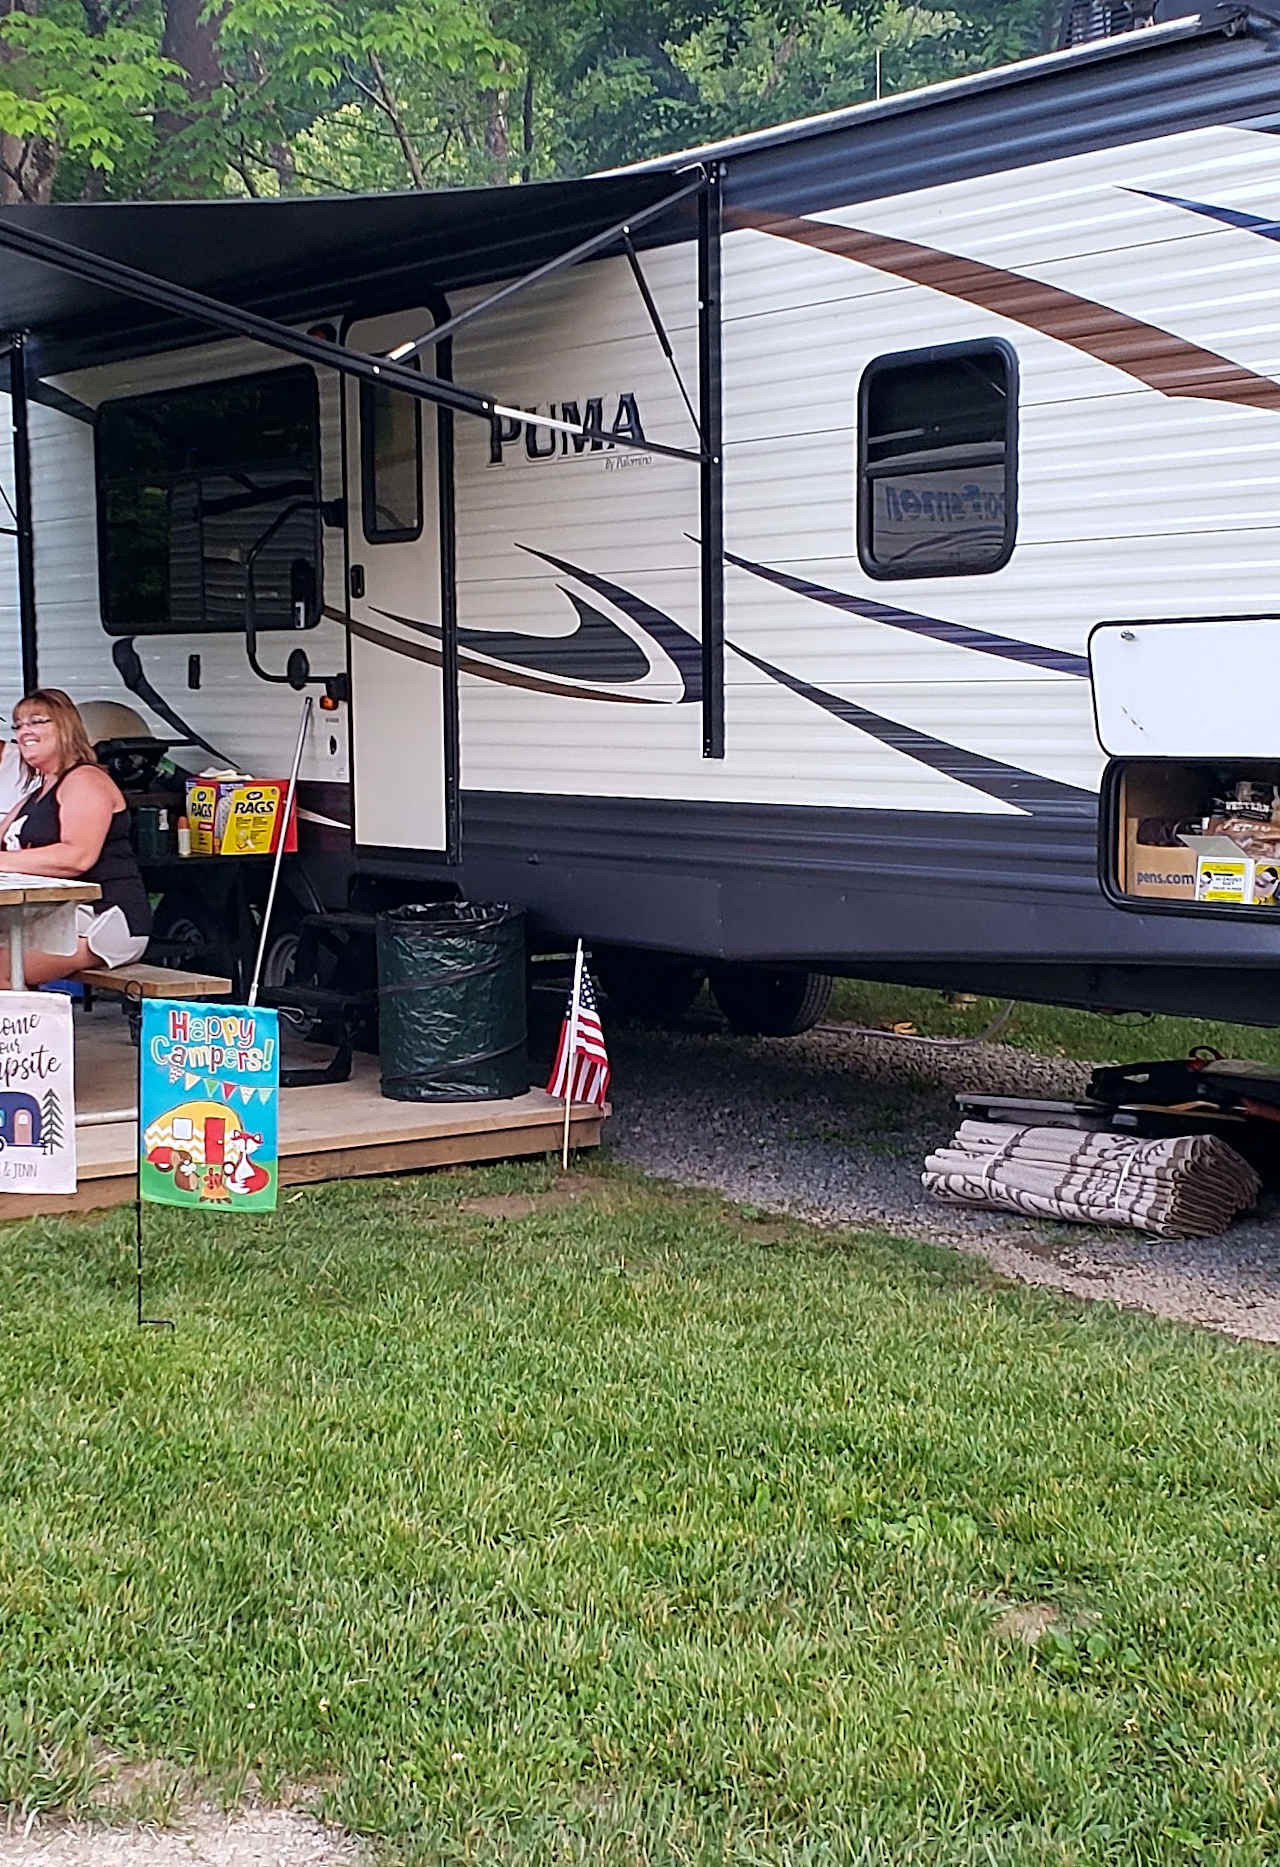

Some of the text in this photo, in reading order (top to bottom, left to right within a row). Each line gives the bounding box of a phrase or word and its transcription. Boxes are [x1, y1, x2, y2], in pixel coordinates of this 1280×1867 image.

[488, 391, 647, 467] PUMA
[234, 801, 275, 814] RAGS
[1137, 871, 1195, 885] pens.com
[169, 1010, 256, 1048] Happy
[0, 1038, 22, 1054] our
[151, 1035, 275, 1073] Campers!
